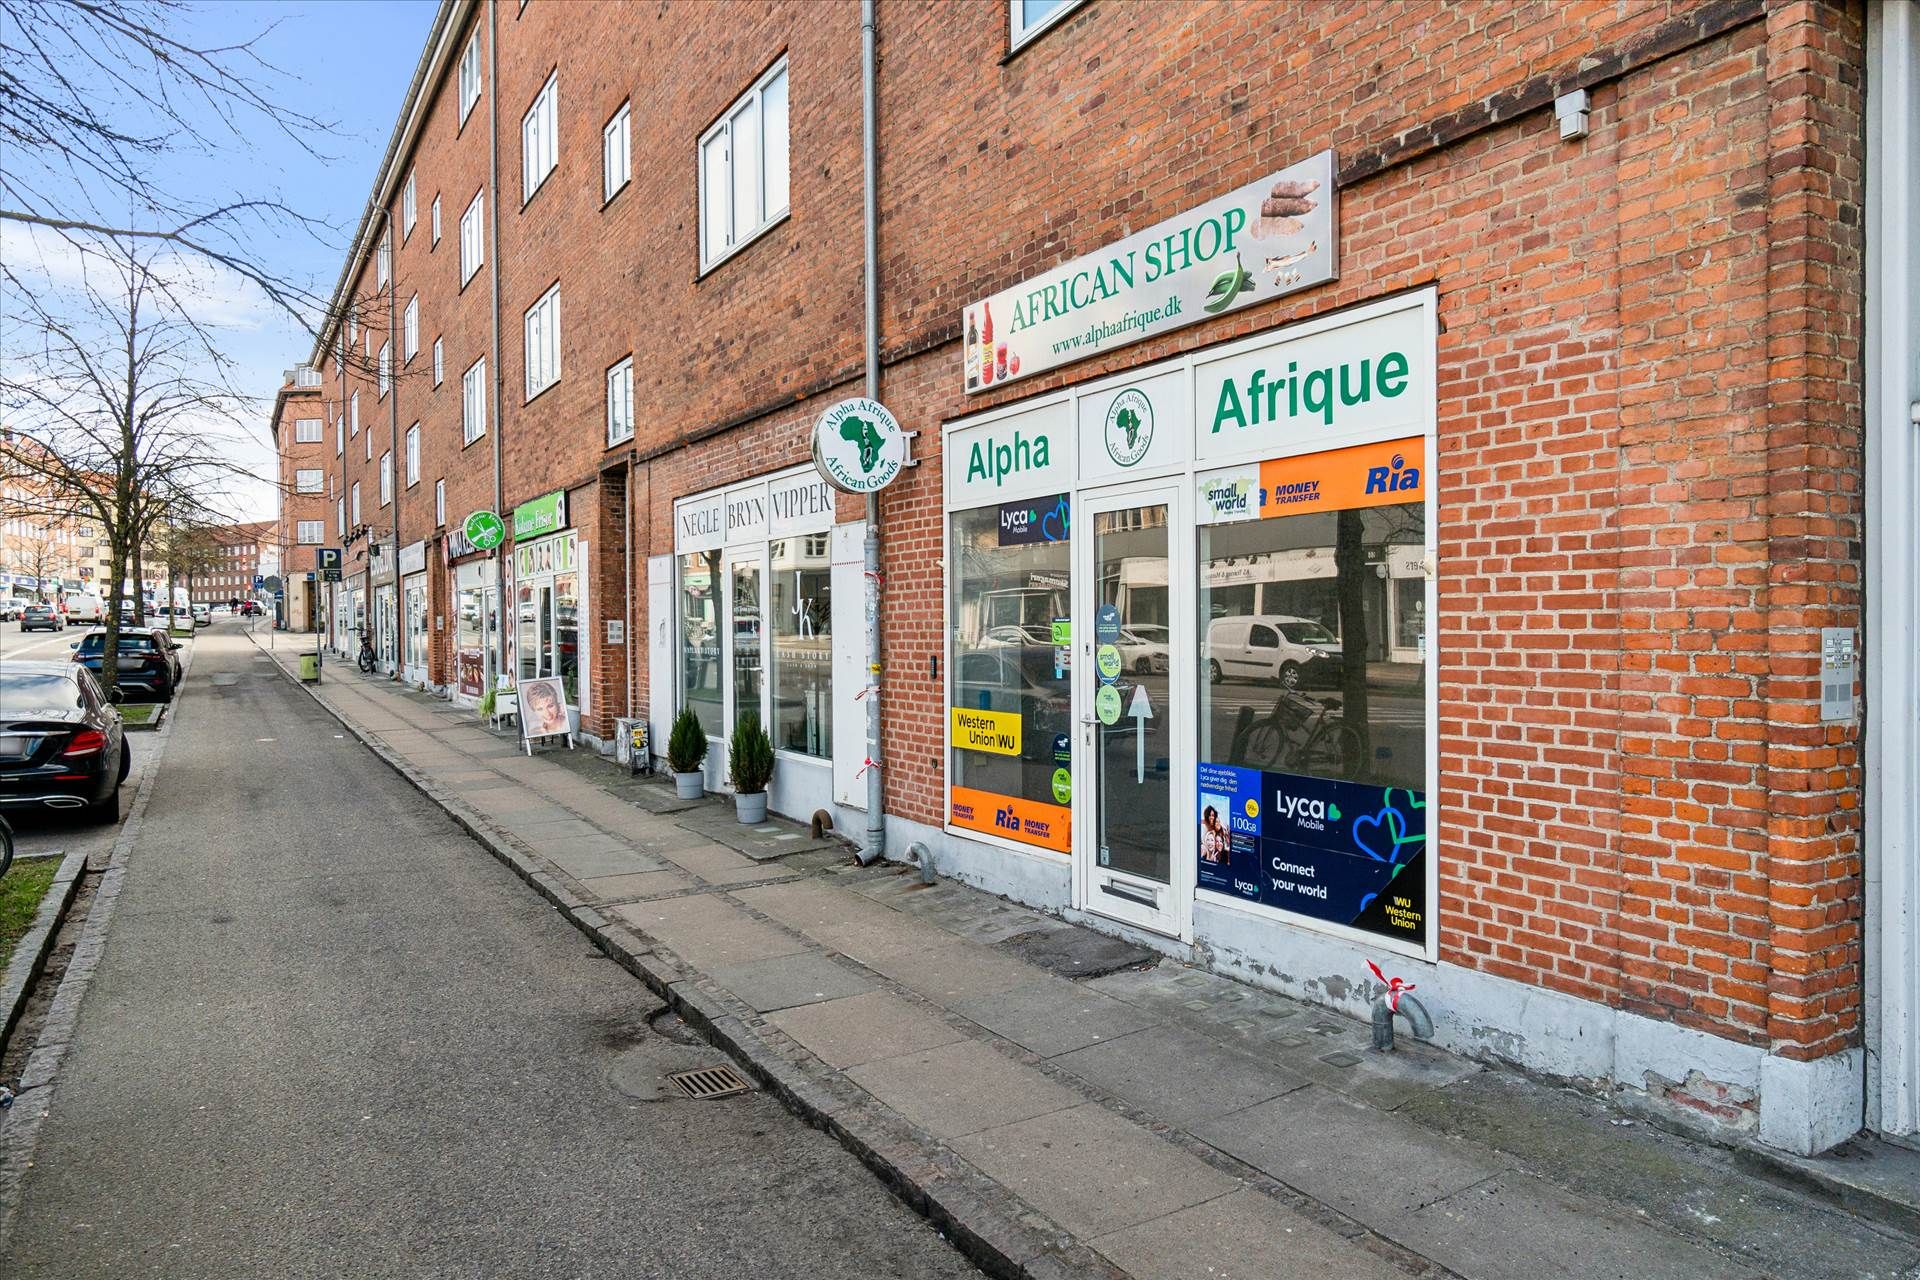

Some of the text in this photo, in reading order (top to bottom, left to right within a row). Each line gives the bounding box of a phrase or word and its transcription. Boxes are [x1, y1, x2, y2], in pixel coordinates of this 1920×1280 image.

[1009, 207, 1246, 334] AFRICAN SHOP
[1052, 296, 1182, 355] www.alphaafrique.dk
[1212, 352, 1409, 434] Afrique
[826, 400, 895, 432] Alpha Afrique
[1110, 393, 1148, 423] Alpha Afrique
[1110, 434, 1149, 462] African Goods
[966, 430, 1050, 486] Alpha
[826, 457, 898, 489] African Goods
[1365, 454, 1420, 494] Ria
[1208, 483, 1237, 500] small
[1275, 480, 1320, 496] MONEY
[1215, 493, 1247, 511] world
[1275, 492, 1320, 505] TRANSFER
[682, 482, 832, 538] NEGLE BRYN VIPPER
[1001, 510, 1028, 529] Lyca
[323, 550, 337, 567] P
[801, 650, 831, 661] STORY
[958, 714, 995, 731] Western
[969, 730, 1015, 749] Union WU
[953, 803, 974, 814] MONEY
[1277, 790, 1324, 818] Lyca
[953, 811, 974, 821] TRANSFER
[995, 804, 1020, 831] Ria
[1024, 819, 1050, 831] MONEY
[1297, 817, 1324, 831] Mobile
[1024, 827, 1050, 839] TRANSFER
[1272, 857, 1315, 878] Connect
[1235, 878, 1253, 891] Lyca
[1272, 878, 1327, 899] your world
[1393, 896, 1411, 908] WU
[1385, 905, 1421, 922] Western
[1391, 916, 1415, 930] Union
